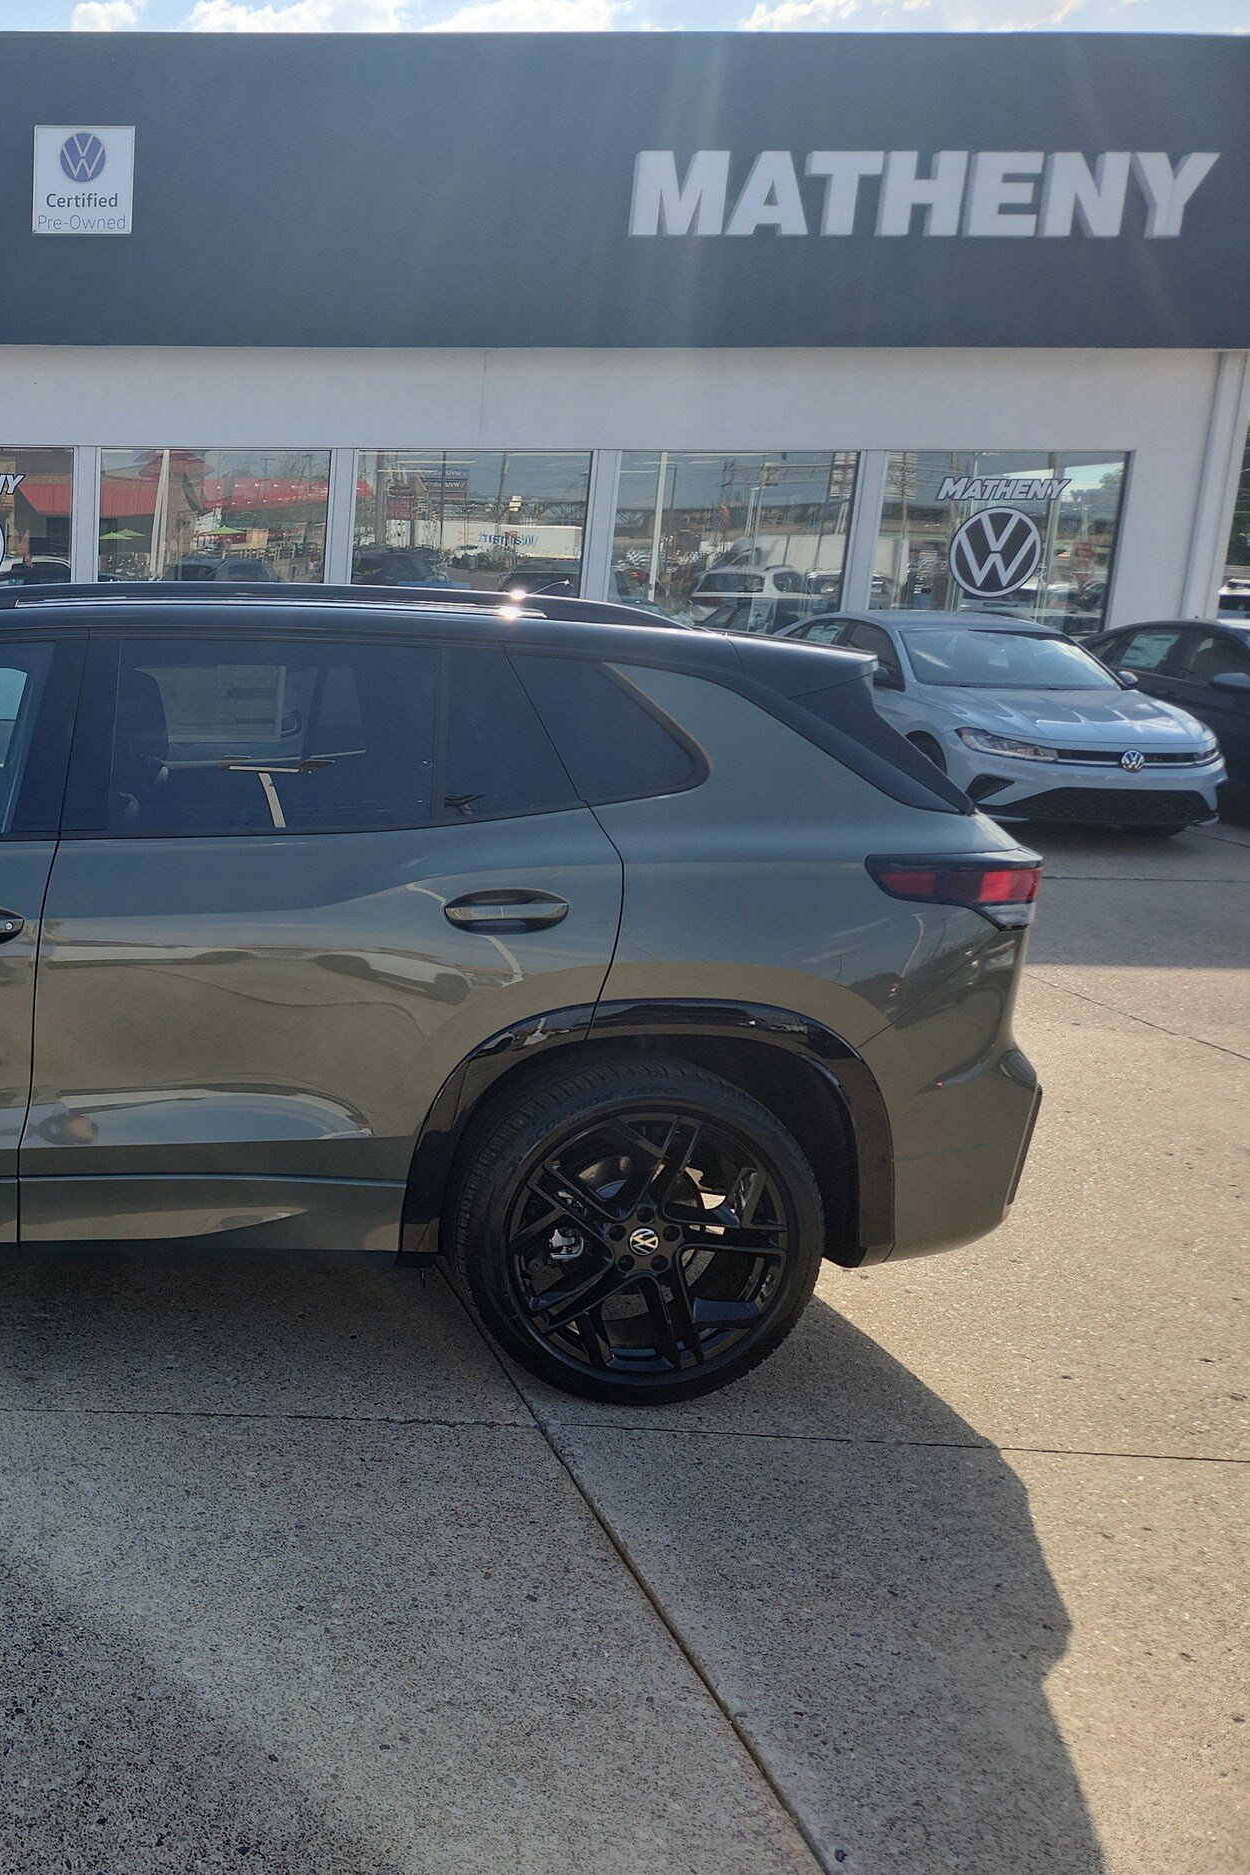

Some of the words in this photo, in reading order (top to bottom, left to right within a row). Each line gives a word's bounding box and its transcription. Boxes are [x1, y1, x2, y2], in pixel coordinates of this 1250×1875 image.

[46, 193, 118, 208] Certified
[628, 150, 1220, 239] MATHENY
[37, 214, 126, 230] Pre-Owned
[937, 477, 1072, 500] MATHENY
